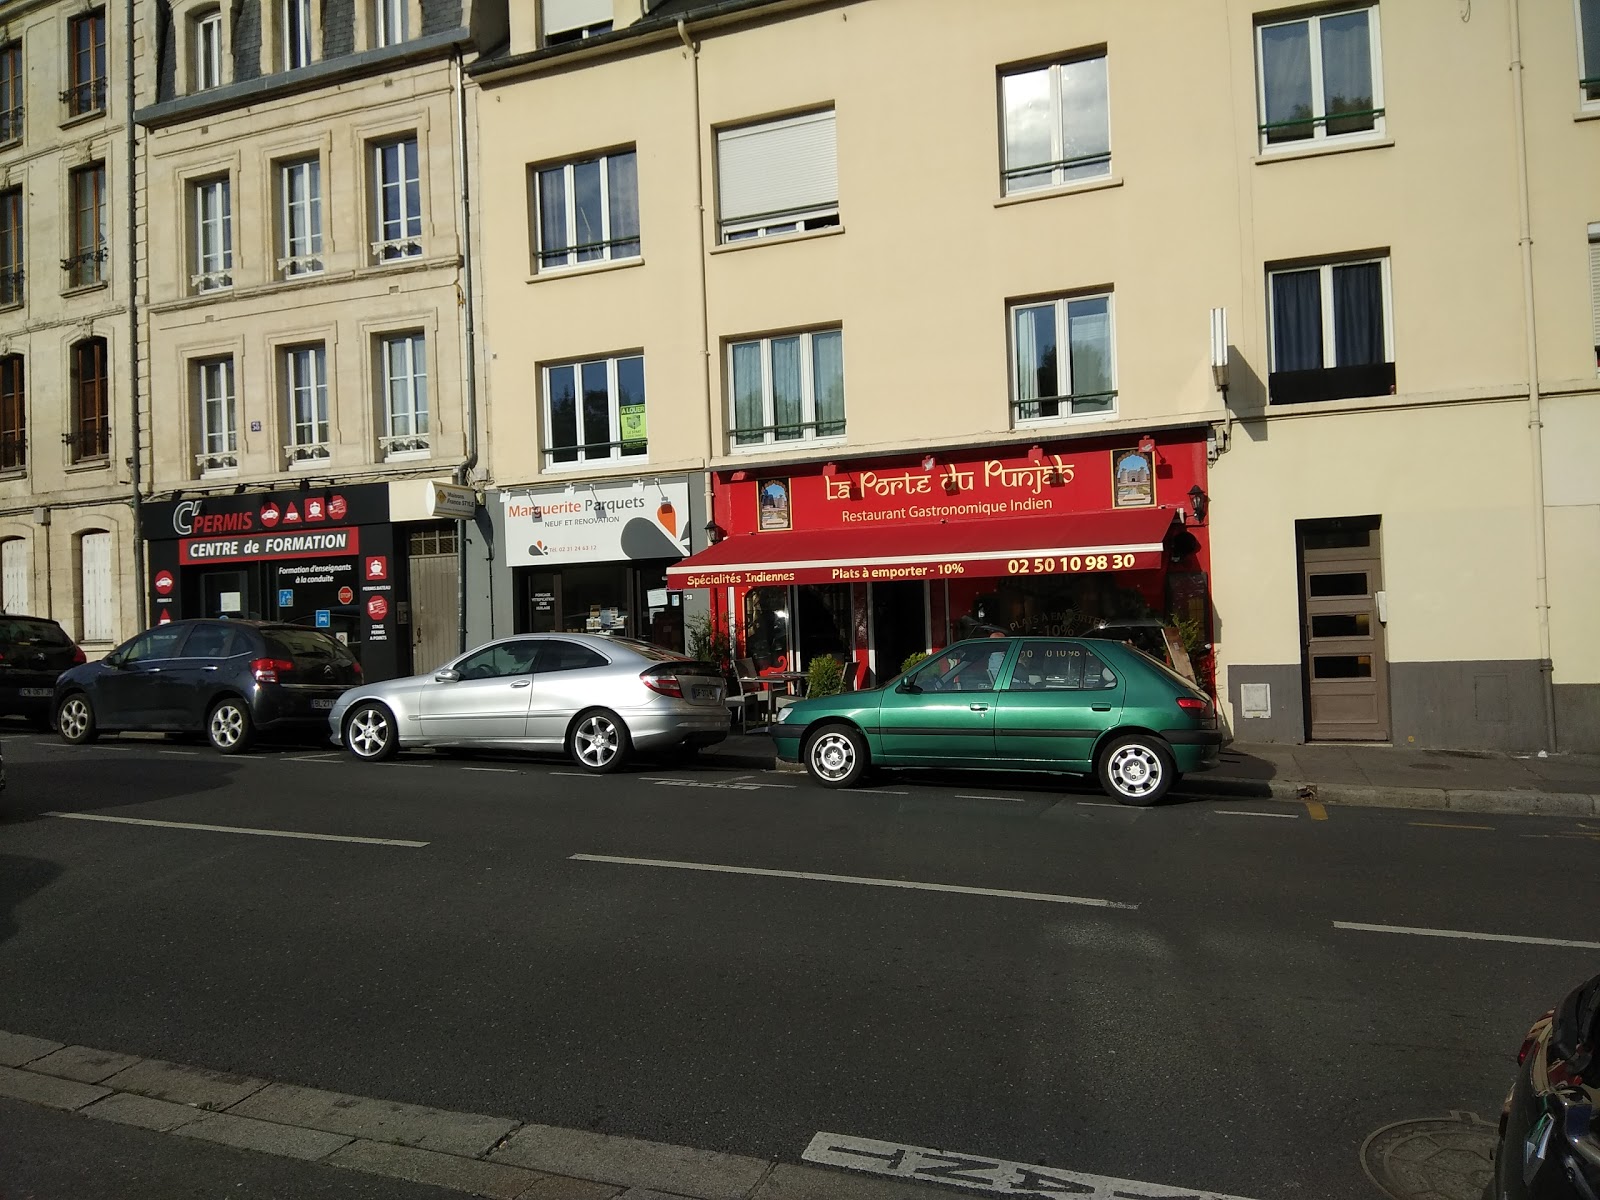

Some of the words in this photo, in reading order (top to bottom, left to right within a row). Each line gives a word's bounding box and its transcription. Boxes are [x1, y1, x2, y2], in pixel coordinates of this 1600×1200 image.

[825, 475, 852, 500] La
[860, 472, 931, 498] Porte
[940, 464, 974, 492] du
[984, 455, 1074, 495] Punjab
[508, 501, 581, 518] Marguerite
[585, 497, 644, 513] Parquets
[842, 507, 906, 522] Restaurant
[909, 501, 1006, 518] Gastronomique
[1010, 498, 1053, 511] Indien
[575, 516, 619, 526] RENOVATION
[190, 541, 238, 557] CENTRE
[244, 540, 259, 554] de
[266, 534, 346, 552] FORMATION
[278, 566, 309, 574] Formation
[310, 564, 352, 574] d'enseignants
[832, 568, 860, 580] Plats
[862, 567, 870, 578] à
[872, 566, 928, 580] emporter
[1008, 559, 1029, 574] 02
[1034, 558, 1055, 573] 50
[1060, 556, 1081, 571] 10
[1085, 555, 1108, 570] 98
[1112, 554, 1135, 569] 30
[687, 573, 741, 588] Spécialités
[745, 571, 795, 584] Indiennes
[1010, 616, 1038, 631] PLATS
[1052, 612, 1106, 626] EMORTER
